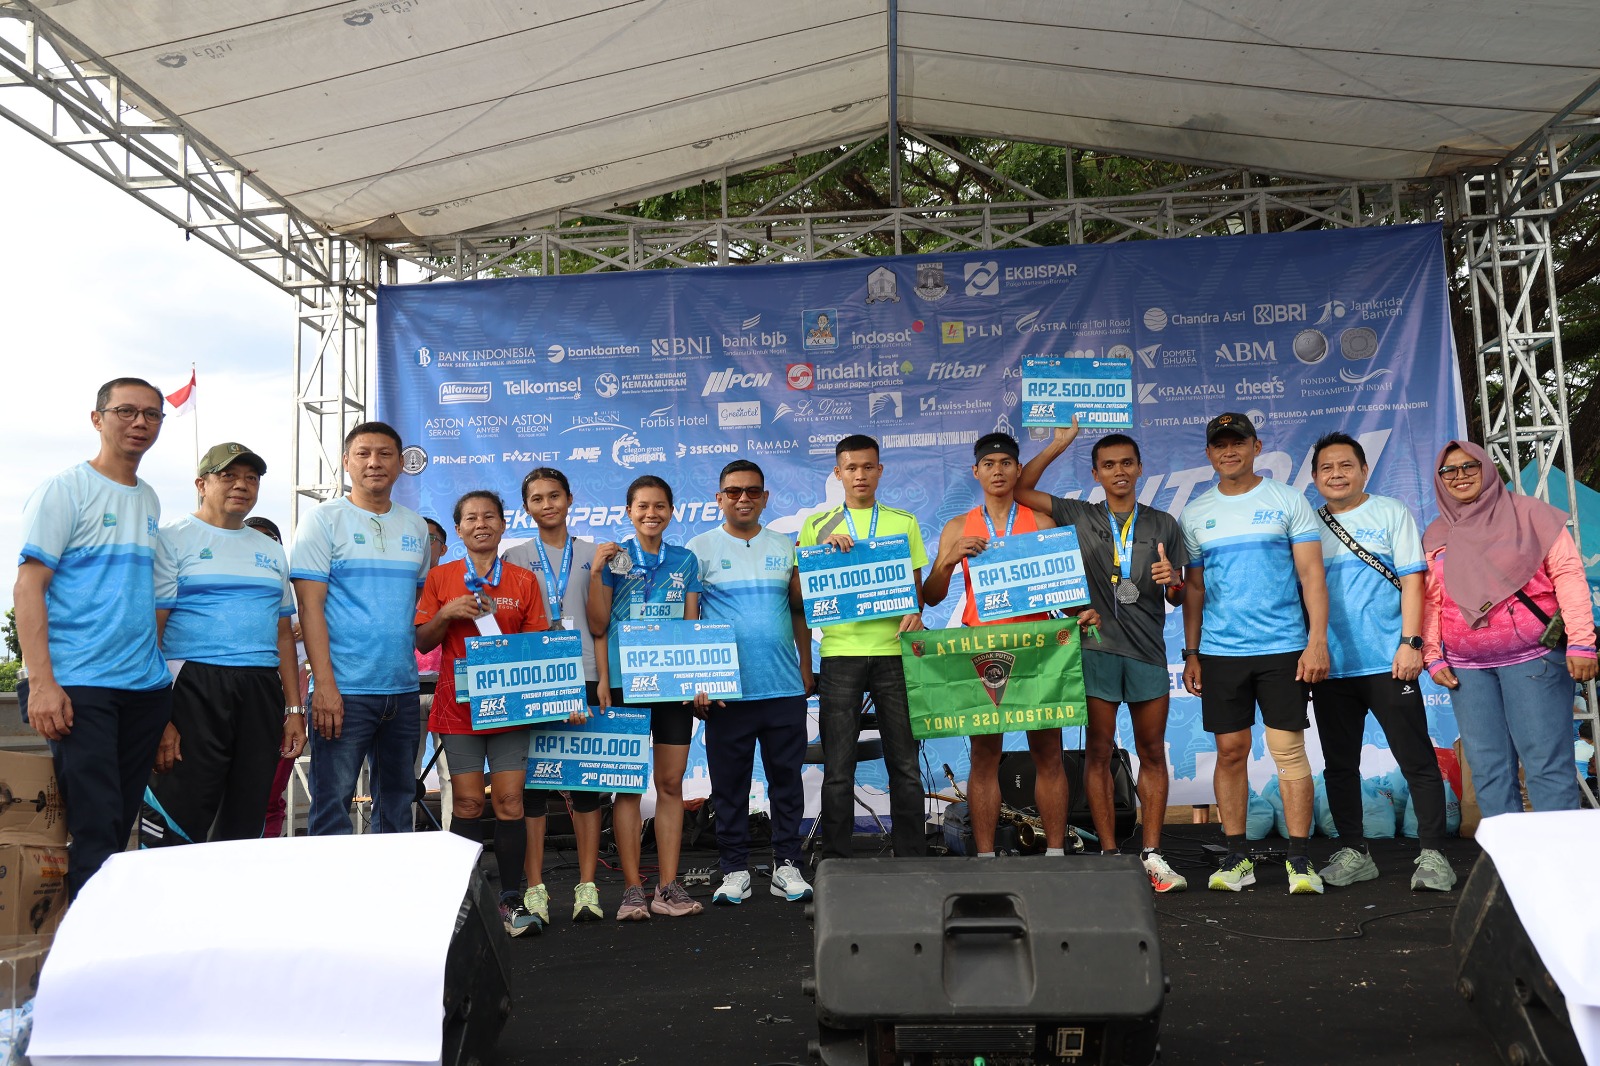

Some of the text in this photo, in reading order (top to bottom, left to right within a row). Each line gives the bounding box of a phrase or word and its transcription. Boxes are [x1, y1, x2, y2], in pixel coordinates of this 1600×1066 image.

[1005, 264, 1078, 280] EKBISPAR
[1350, 297, 1402, 310] Jamkrida
[1172, 311, 1246, 326] Chandra Asri
[1274, 304, 1306, 322] BRI
[1362, 308, 1402, 320] Banten
[966, 324, 1002, 338] PLN
[1032, 318, 1130, 332] ASTRA Infra Toll Road
[1072, 328, 1130, 336] TANGERANG-MERAK
[722, 332, 787, 348] bank bjb
[852, 329, 912, 344] indosat
[568, 344, 640, 357] bankbanten
[673, 336, 711, 356] BNI
[1215, 341, 1277, 362] ABM
[438, 348, 535, 361] BANK INDONESIA
[816, 361, 900, 380] indah kiat
[927, 362, 986, 380] Fitbar
[503, 377, 582, 396] Telkomsel
[622, 378, 687, 389] KEMAKMURAN
[728, 372, 772, 388] PCM
[817, 383, 834, 391] pulp
[850, 382, 871, 390] paper
[872, 379, 904, 388] products
[1301, 376, 1337, 386] PONDOK
[442, 385, 488, 394] Alfamart
[1028, 382, 1126, 398] RP2.500.000
[1158, 384, 1225, 396] KRAKATAU
[1301, 382, 1392, 398] PENGAMPELAN INDAH
[1074, 412, 1128, 422] 1ST PODIUM
[1269, 401, 1428, 419] PERUMDA AIR MINUM CILEGON MANDIRI
[425, 418, 464, 429] ASTON
[468, 416, 508, 426] ASTON
[512, 414, 552, 426] ASTON
[640, 415, 708, 428] Forbis Hotel
[1154, 418, 1180, 426] TIRTA
[690, 444, 738, 455] 3SECOND
[748, 440, 798, 450] RAMADA
[433, 454, 496, 464] PRIME POINT
[567, 447, 602, 460] JNE
[1253, 512, 1273, 520] 5K
[1330, 521, 1349, 544] adidas
[1358, 550, 1384, 572] adidas
[978, 556, 1076, 586] RP1.500.000
[808, 564, 906, 593] RP1.000.000
[1028, 588, 1086, 608] 2ND PODIUM
[856, 596, 914, 616] 3RD PODIUM
[936, 633, 1045, 656] ATHLETICS
[627, 648, 731, 668] RP2.500.000
[974, 653, 1012, 663] BADAK PUTIH
[476, 663, 577, 689] RP1.000.000
[680, 681, 737, 694] 1ST PODIUM
[525, 699, 583, 717] 3RD PODIUM
[924, 705, 1075, 730] YONIF 320 KOSTRAD
[535, 736, 640, 756] RP1.500.000
[582, 773, 643, 787] 2ND PODIUM
